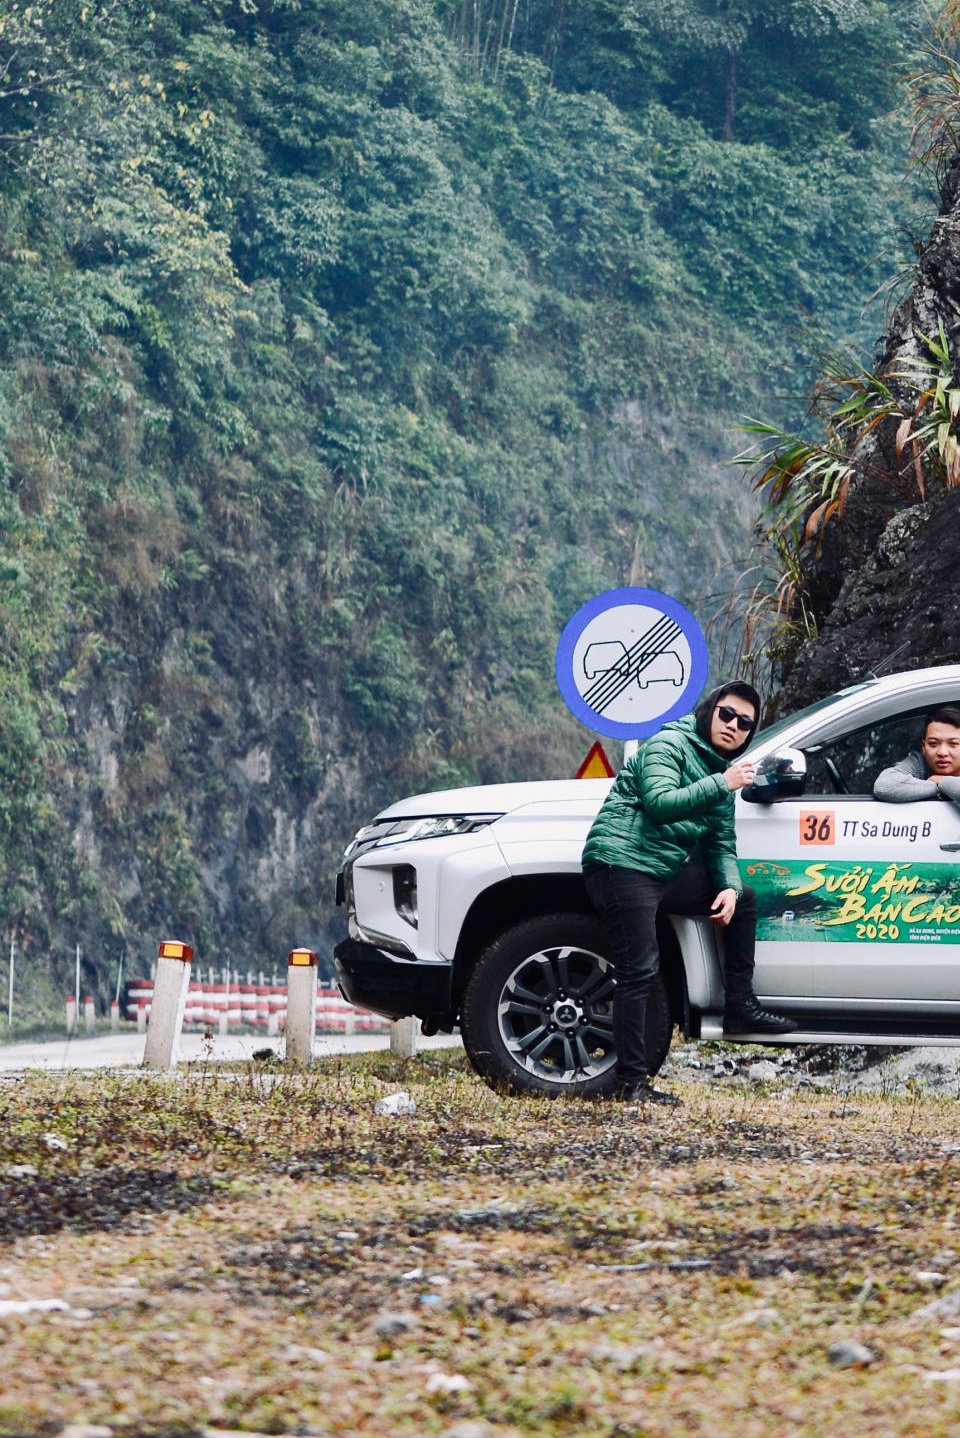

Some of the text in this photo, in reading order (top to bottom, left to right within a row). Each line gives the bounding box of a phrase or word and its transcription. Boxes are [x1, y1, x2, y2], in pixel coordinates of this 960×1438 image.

[803, 814, 932, 843] 36 TT Sa Dung B
[855, 923, 900, 940] 2020
